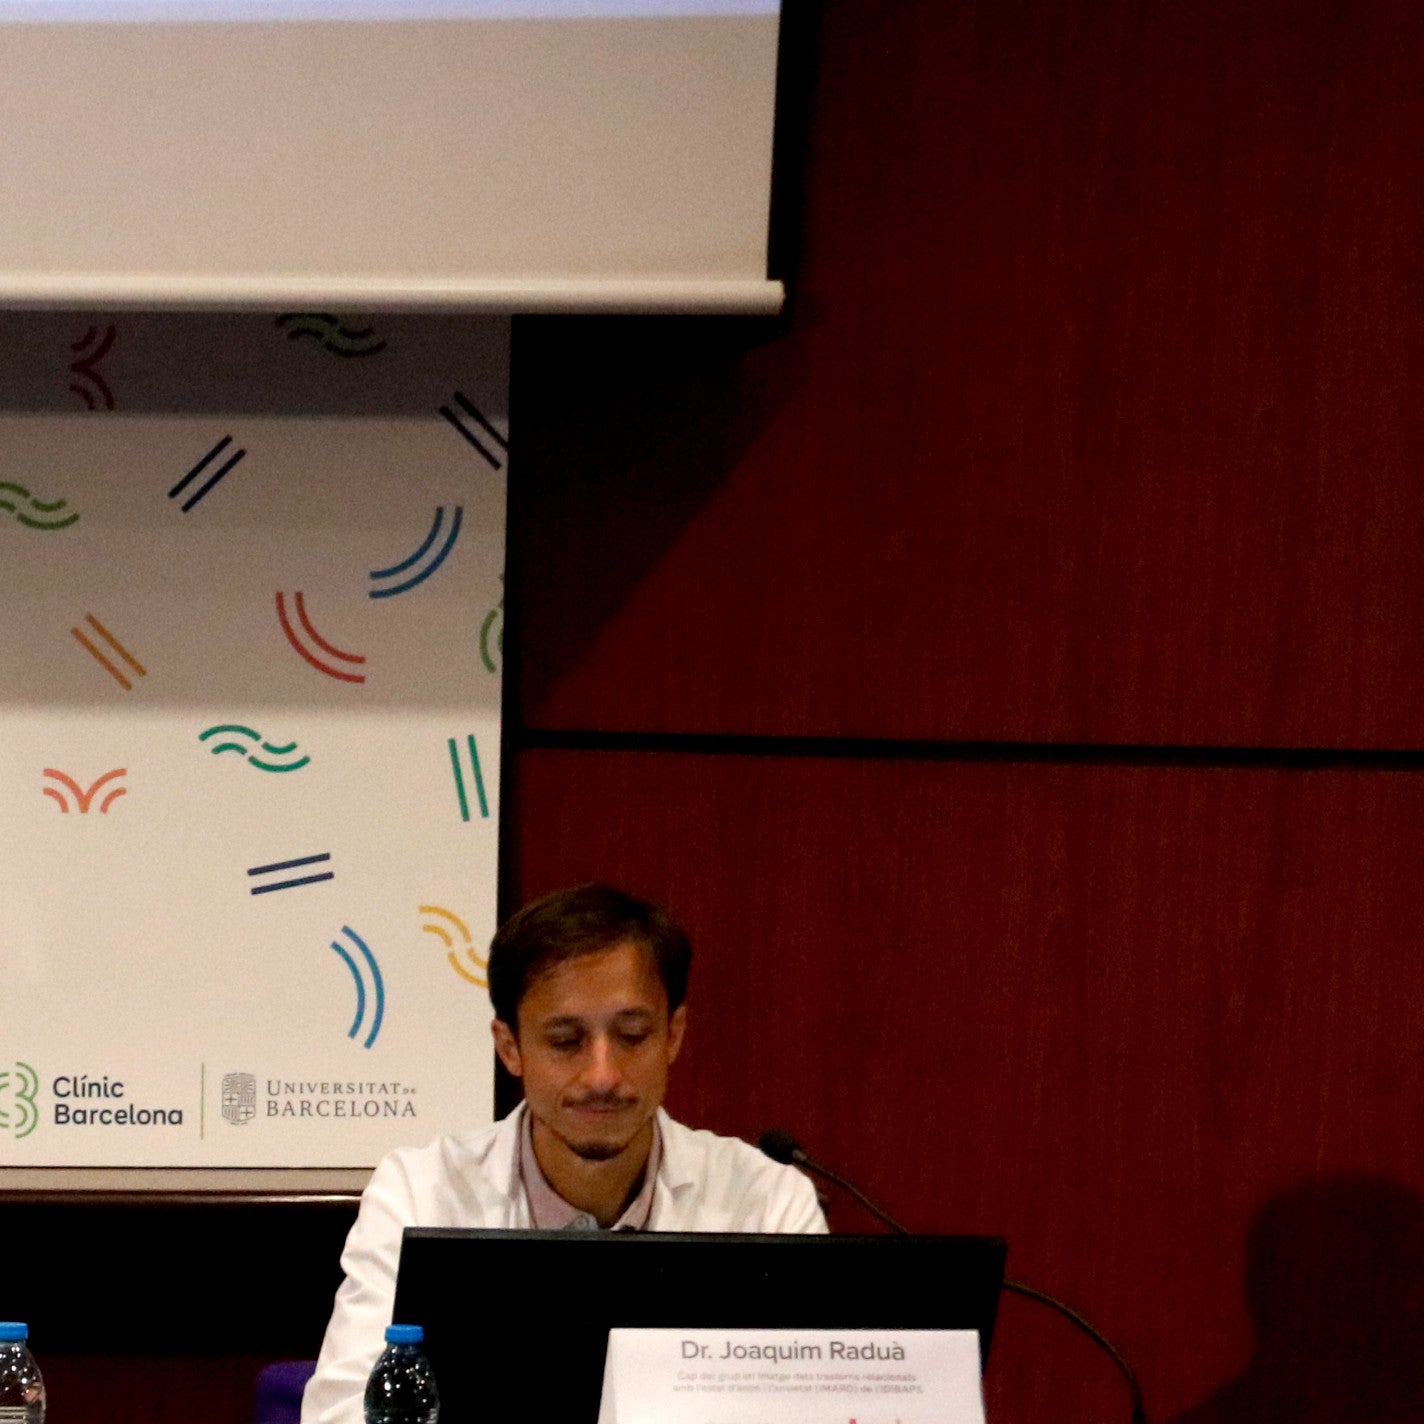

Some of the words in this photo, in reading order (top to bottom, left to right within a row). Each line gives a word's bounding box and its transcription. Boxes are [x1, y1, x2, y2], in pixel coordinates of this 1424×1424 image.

[53, 1074, 123, 1098] Clínic
[267, 1080, 400, 1096] UNIVERSITAT
[55, 1104, 183, 1125] Barcelona
[267, 1100, 416, 1117] BARCELONA
[681, 1340, 712, 1359] Dr.
[719, 1340, 822, 1363] Joaquim
[829, 1341, 905, 1361] Raduà
